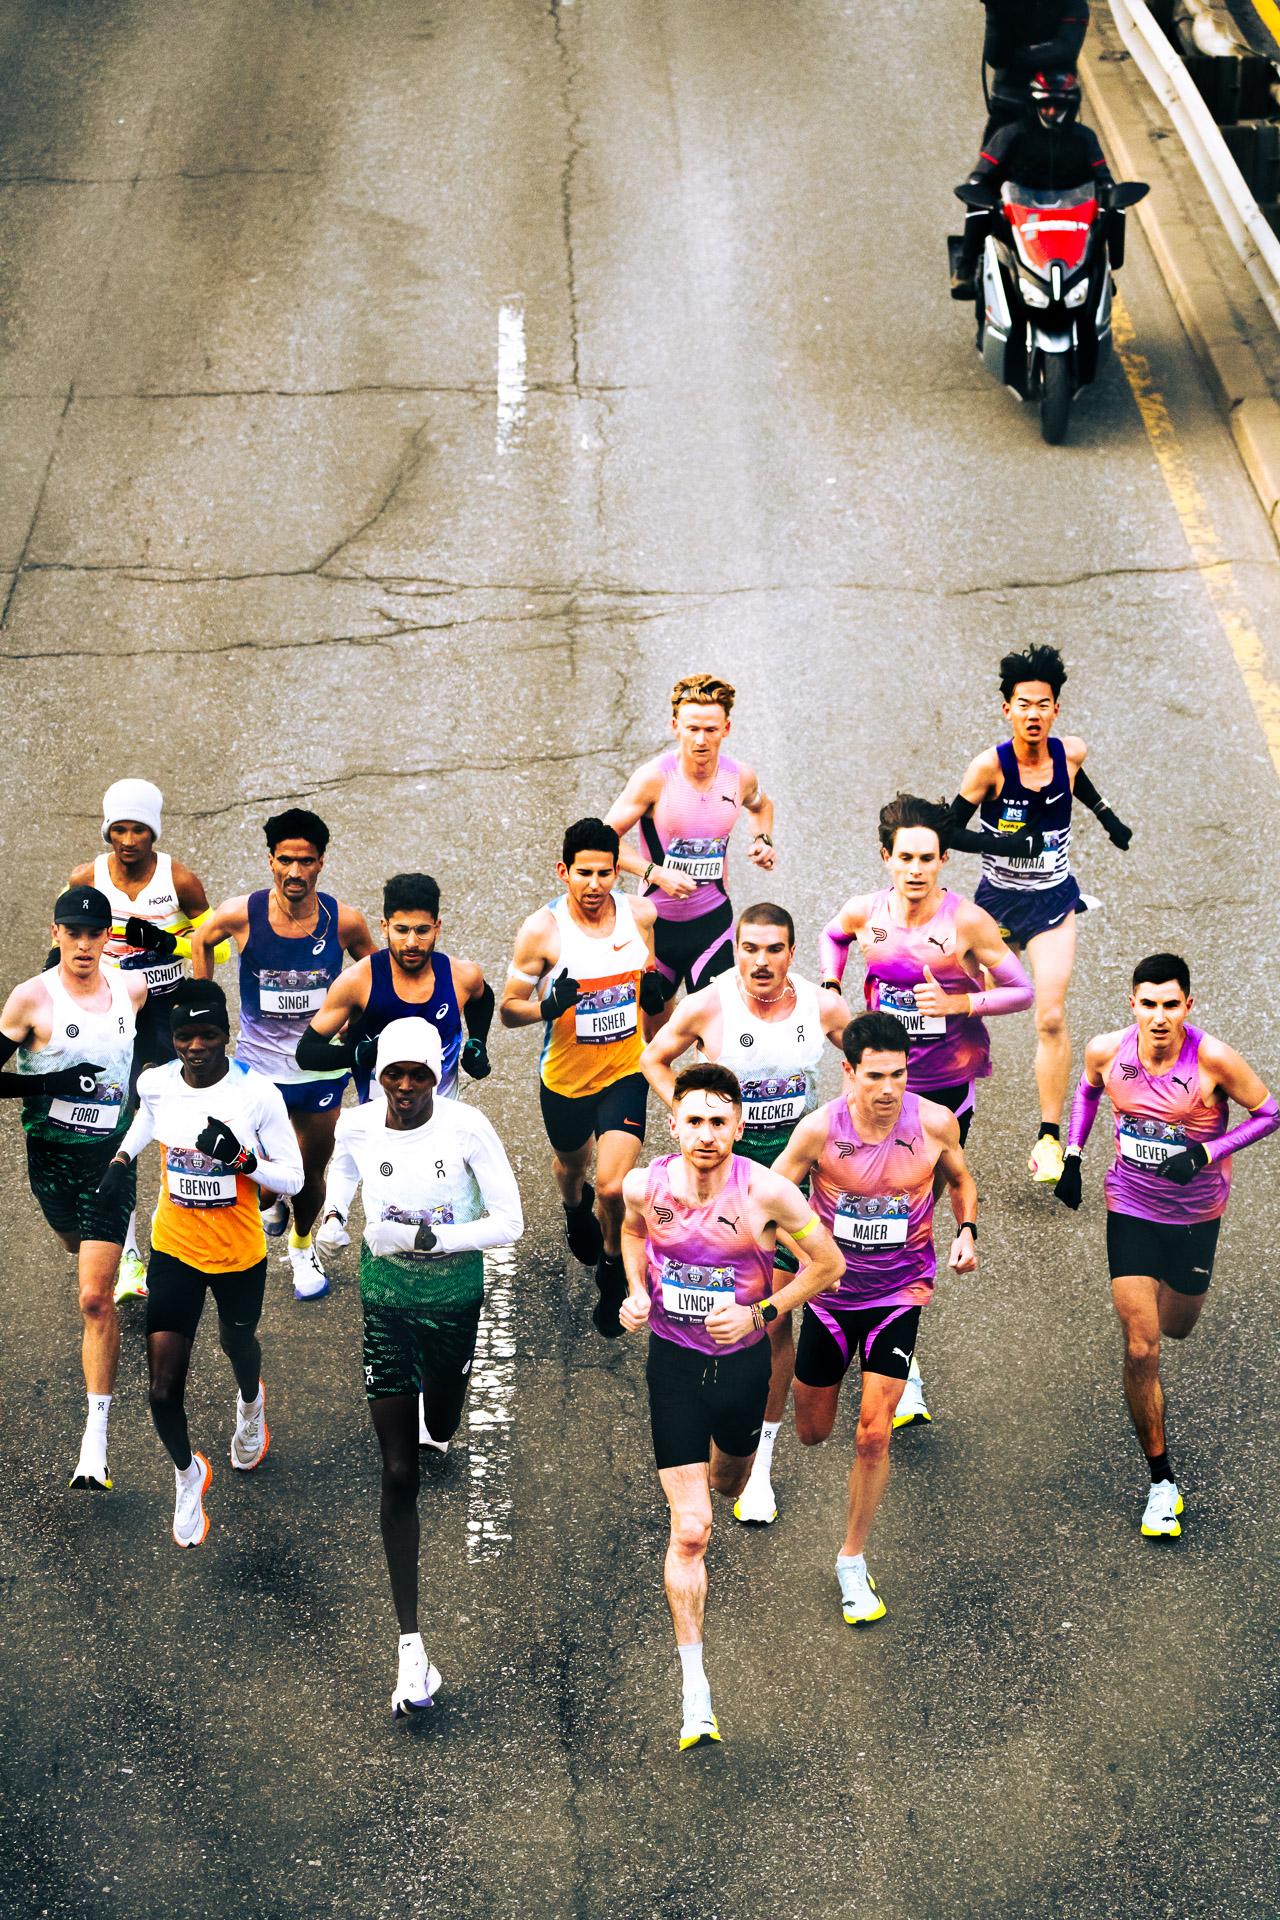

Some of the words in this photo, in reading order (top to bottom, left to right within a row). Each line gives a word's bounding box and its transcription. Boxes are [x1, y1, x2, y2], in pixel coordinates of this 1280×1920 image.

[148, 895, 173, 906] HOKA
[278, 995, 310, 1010] SINGH
[592, 1012, 626, 1033] FISHER
[70, 1107, 100, 1123] FORD
[748, 1103, 794, 1121] KLECKER
[1135, 1143, 1169, 1161] DEVER
[179, 1178, 221, 1197] EBENYO
[852, 1223, 888, 1241] MAIER
[678, 1292, 715, 1313] LYNCH
